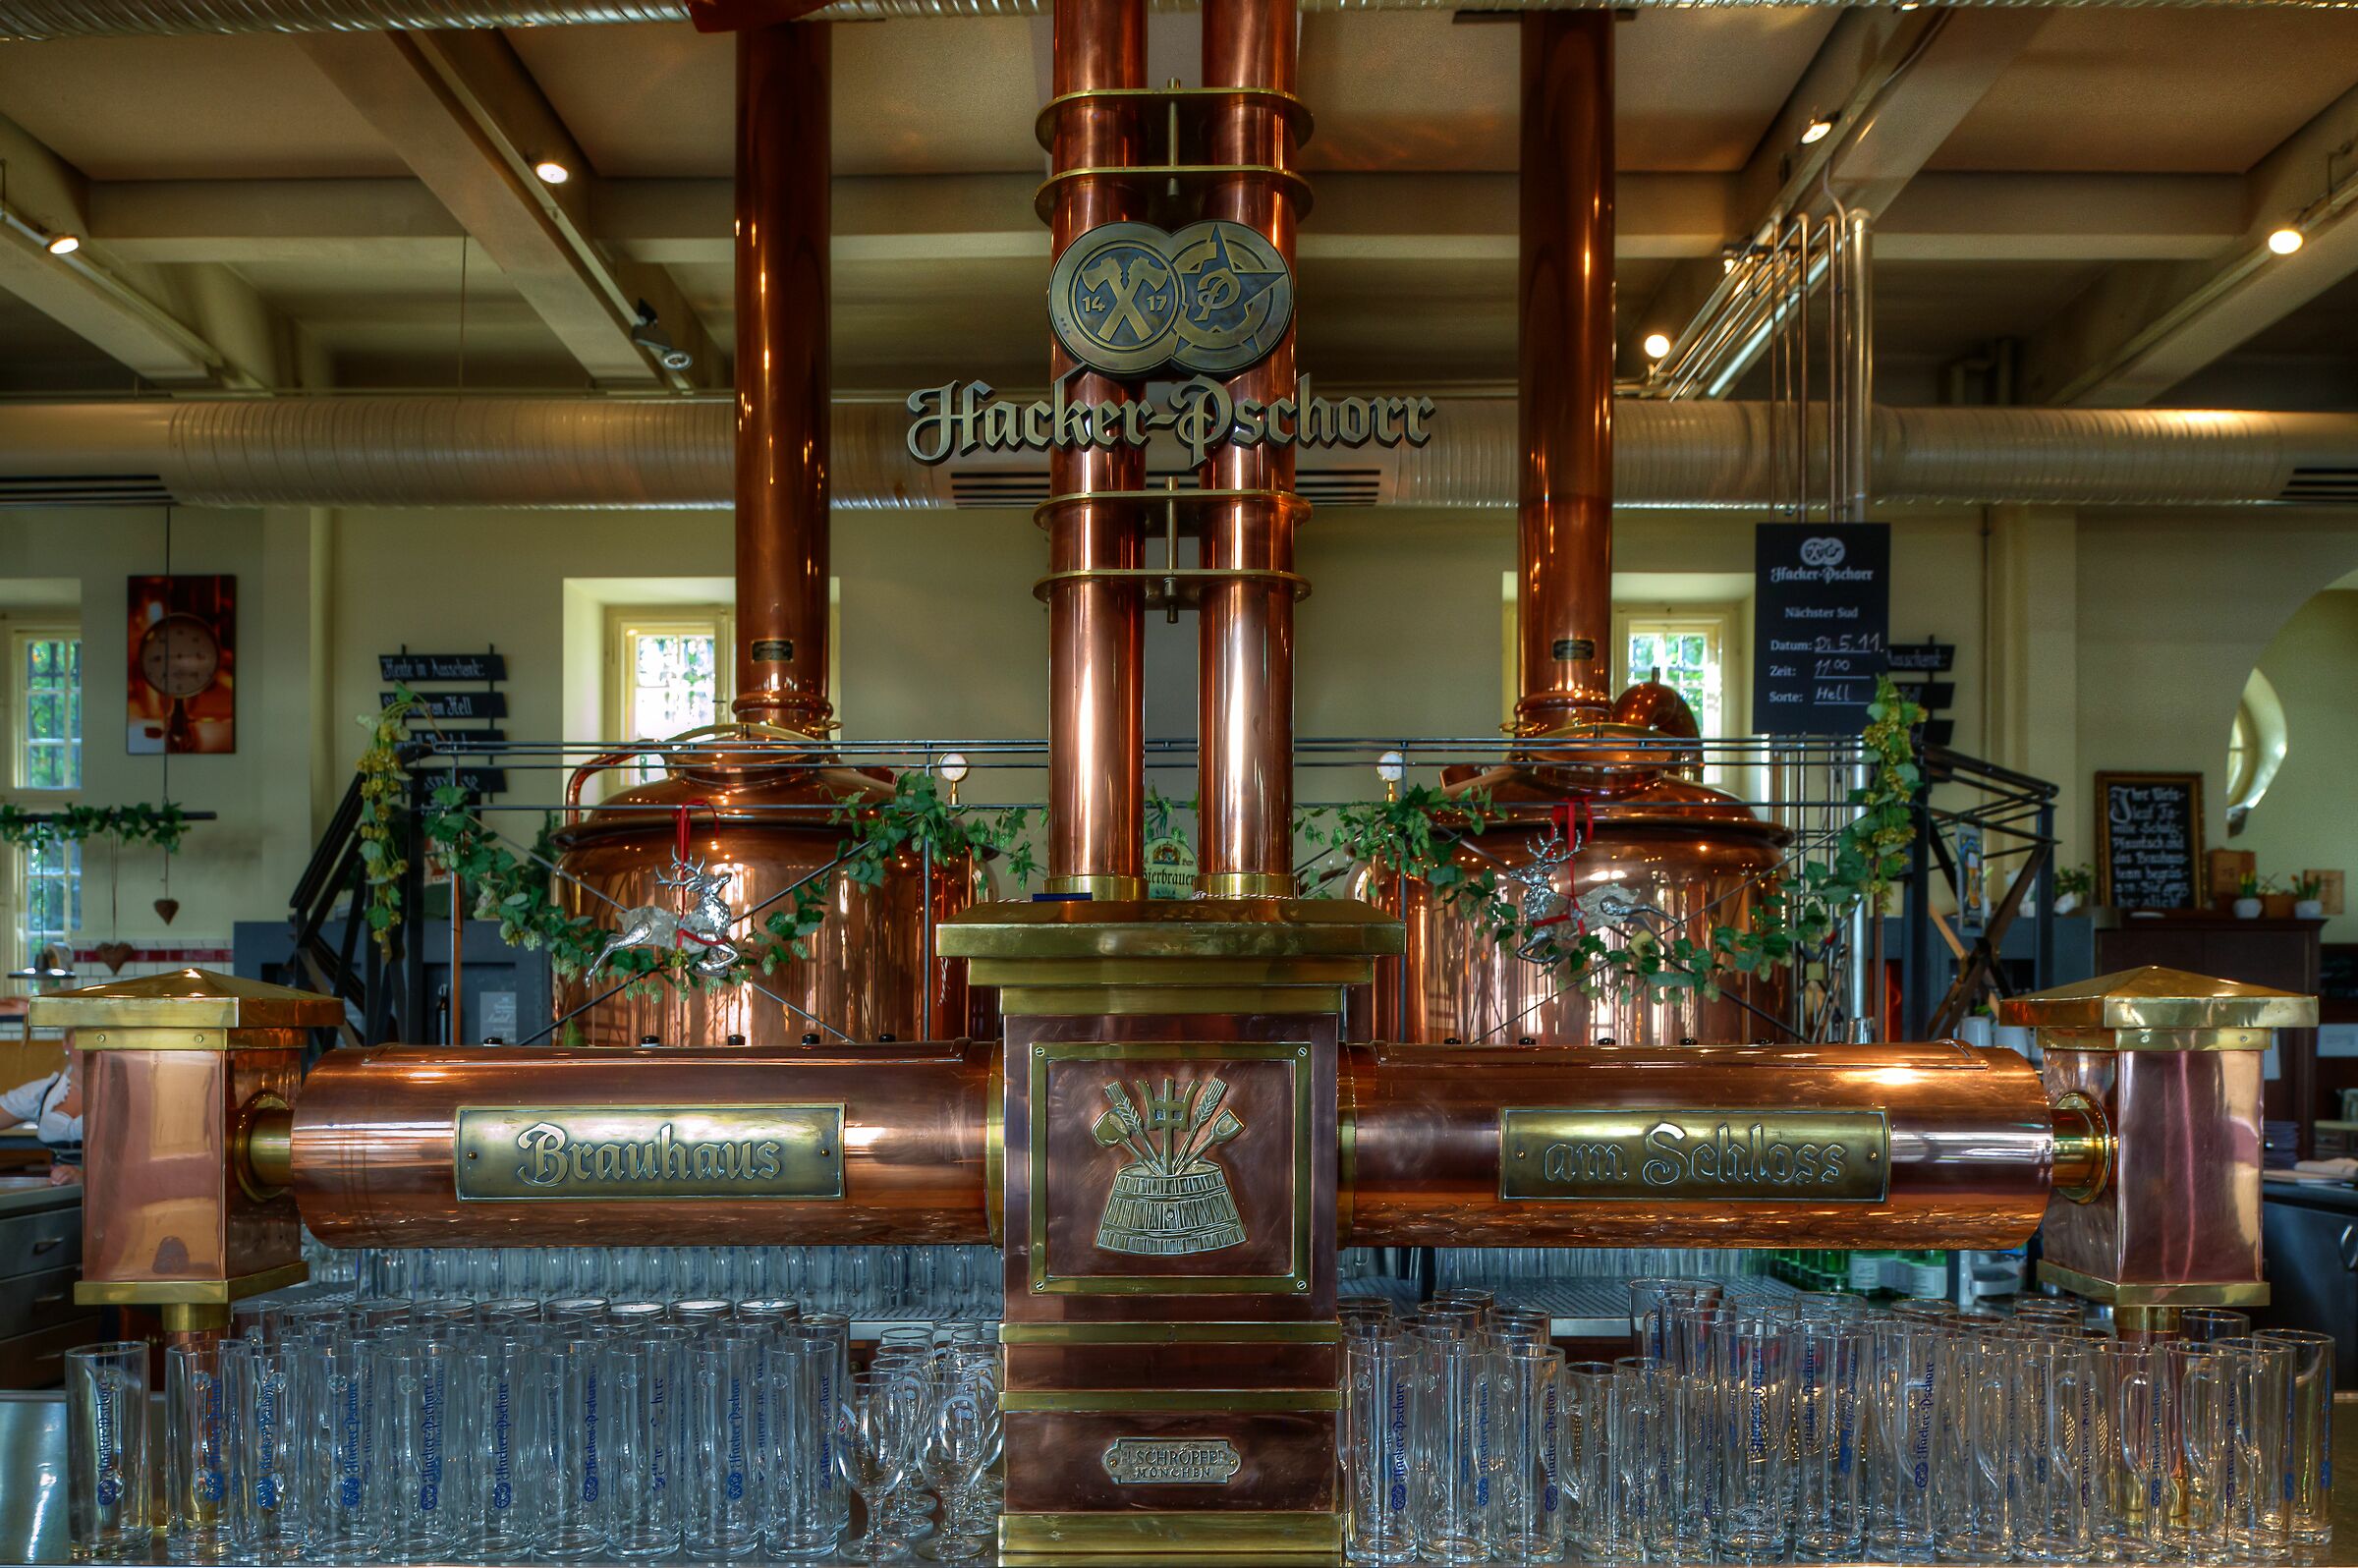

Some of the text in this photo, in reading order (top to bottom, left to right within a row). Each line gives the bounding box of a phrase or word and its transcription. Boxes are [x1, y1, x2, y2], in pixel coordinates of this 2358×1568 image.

[1082, 295, 1167, 313] 14 17
[906, 364, 1435, 470] Hacker-Pschorr
[1770, 566, 1874, 585] Hacker-Pschorr
[1784, 606, 1859, 619] Nächster Sud
[1770, 639, 1813, 651] Datum:
[1769, 665, 1797, 677] Zeit:
[1769, 684, 1850, 703] Sorte: Hell
[516, 1121, 782, 1188] Brauhaus
[1544, 1122, 1849, 1187] am Schloss
[1392, 1382, 1407, 1483] Hacker-Pschorr
[1916, 1362, 1935, 1461] Hacker-Pschorr
[421, 1383, 438, 1483] Hacker-Pschorr
